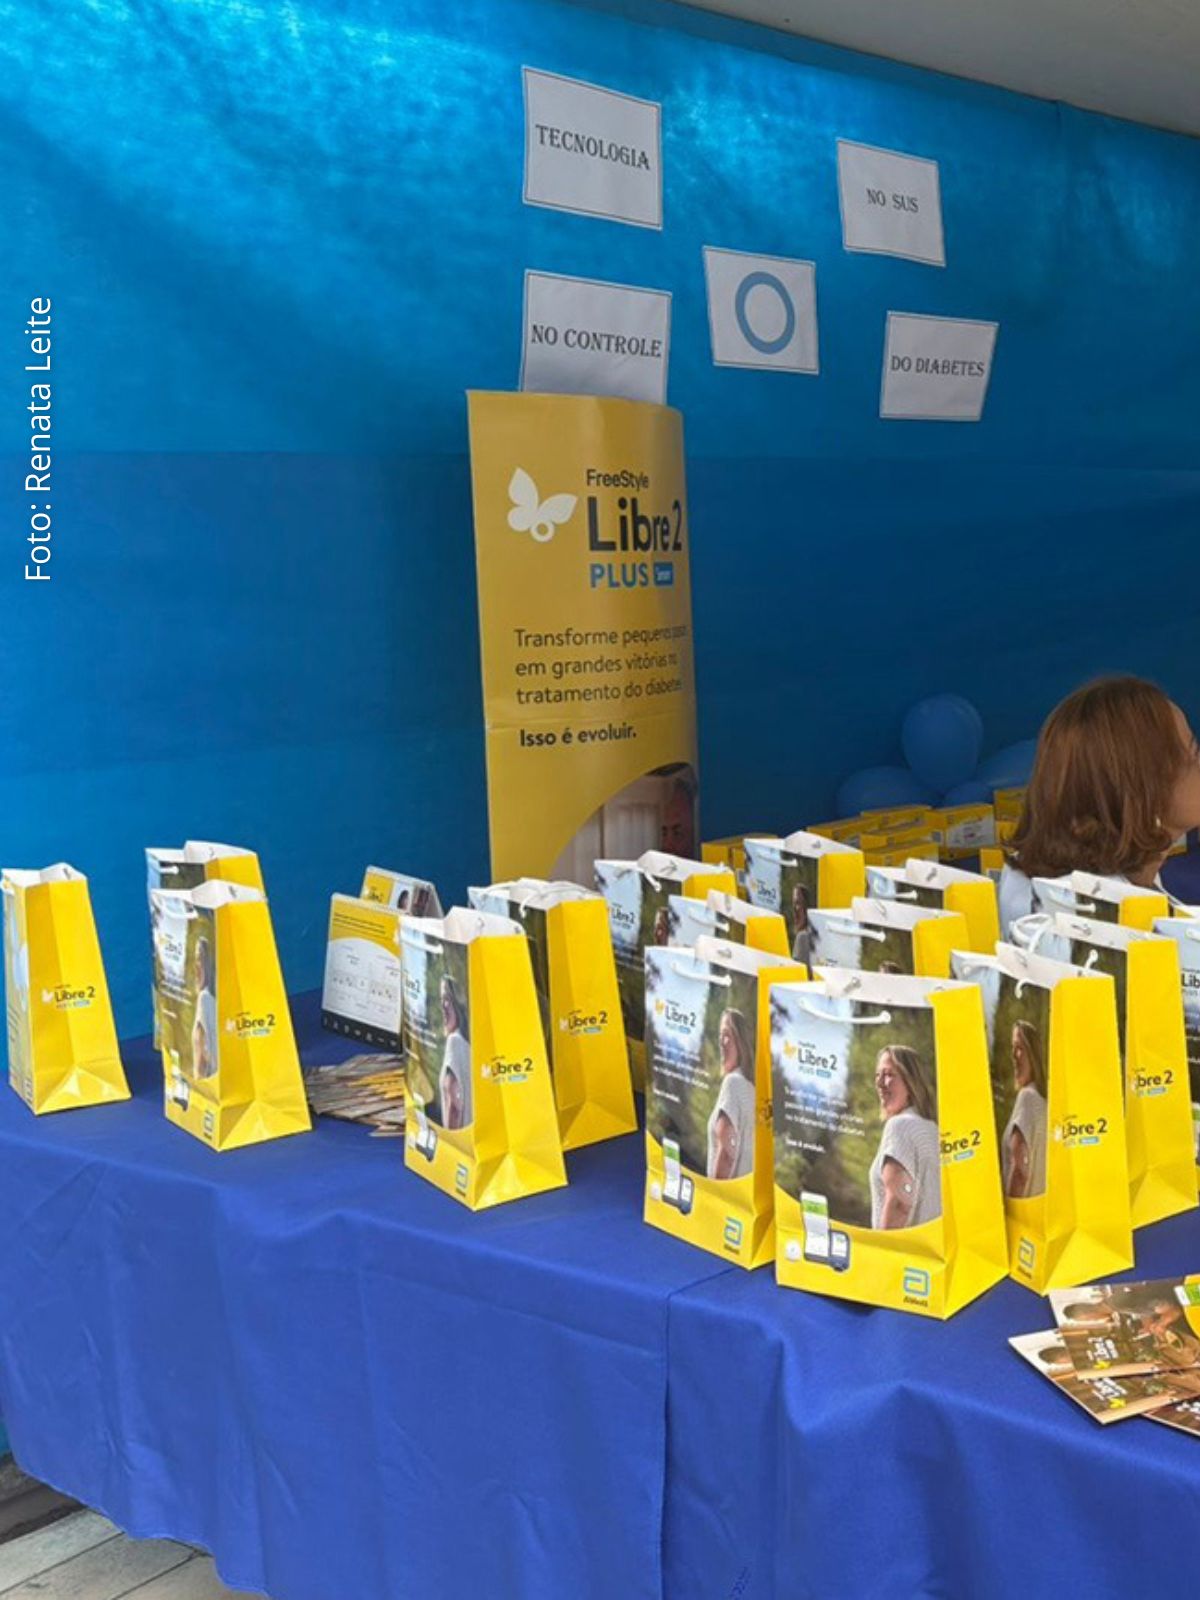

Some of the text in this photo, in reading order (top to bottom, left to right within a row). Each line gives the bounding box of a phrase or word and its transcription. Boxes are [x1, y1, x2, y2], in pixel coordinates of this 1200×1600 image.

[535, 124, 650, 170] TECNOLOGIA
[866, 188, 919, 213] NO SUS
[532, 325, 662, 358] NO CONTROLE
[891, 354, 985, 377] DO DIABETES
[587, 469, 649, 490] FreeStyle
[587, 497, 682, 552] Libre 2
[590, 563, 648, 588] PLUS
[515, 628, 618, 648] Transforme
[516, 662, 545, 677] em
[552, 656, 622, 679] grandes
[517, 685, 621, 705] tratamento
[624, 681, 642, 698] do
[520, 722, 637, 747] Isso é evoluir.
[54, 986, 95, 1003] Libre 2
[236, 1014, 275, 1030] Libre 2
[598, 1010, 608, 1024] 2
[524, 1057, 534, 1072] 2
[798, 1048, 838, 1070] Libre 2
[1164, 1070, 1174, 1084] 2
[1097, 1117, 1108, 1133] 2
[971, 1130, 981, 1146] 2
